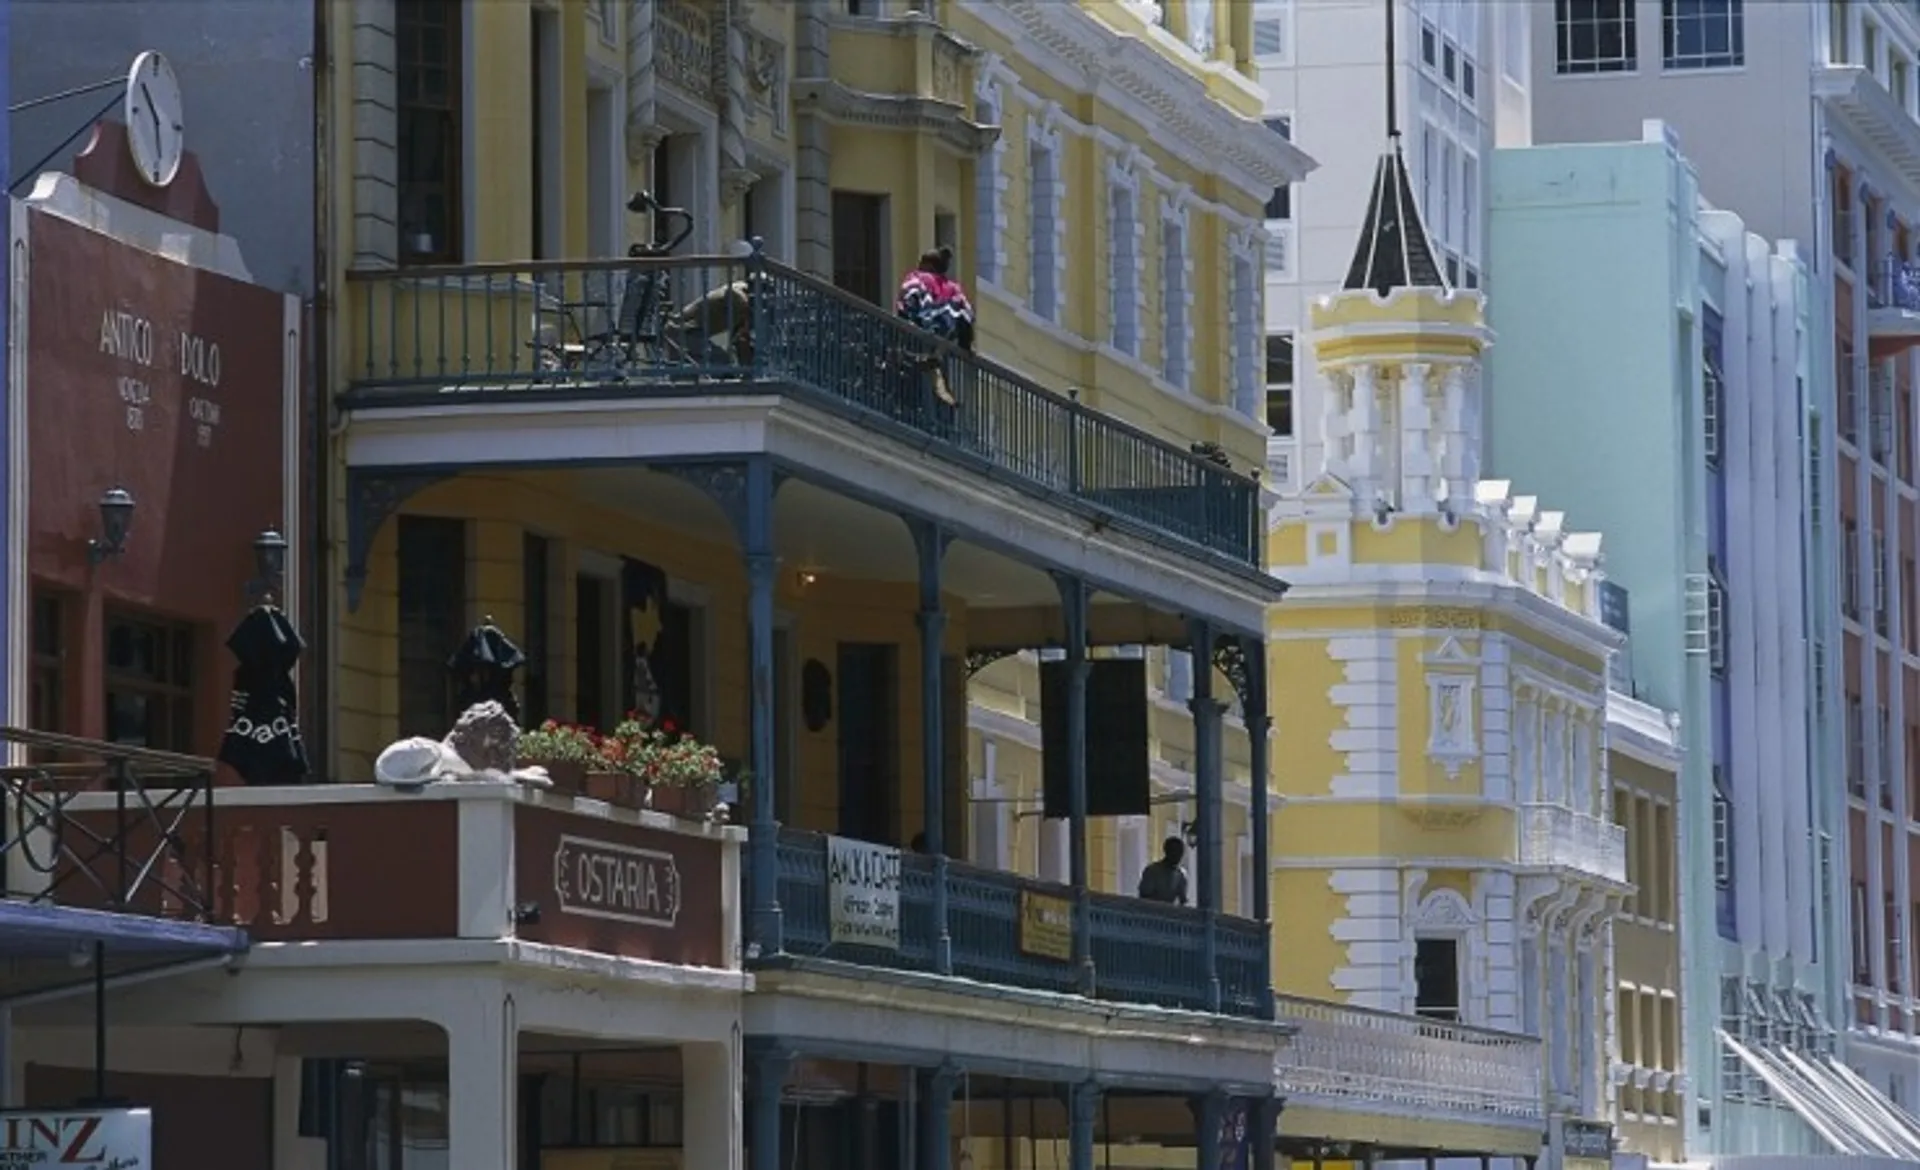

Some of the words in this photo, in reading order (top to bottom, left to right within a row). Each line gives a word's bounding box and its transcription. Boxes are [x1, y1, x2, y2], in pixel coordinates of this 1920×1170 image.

[98, 309, 153, 367] ANTICO
[180, 331, 220, 388] DOLO
[577, 852, 661, 913] OSTARIA
